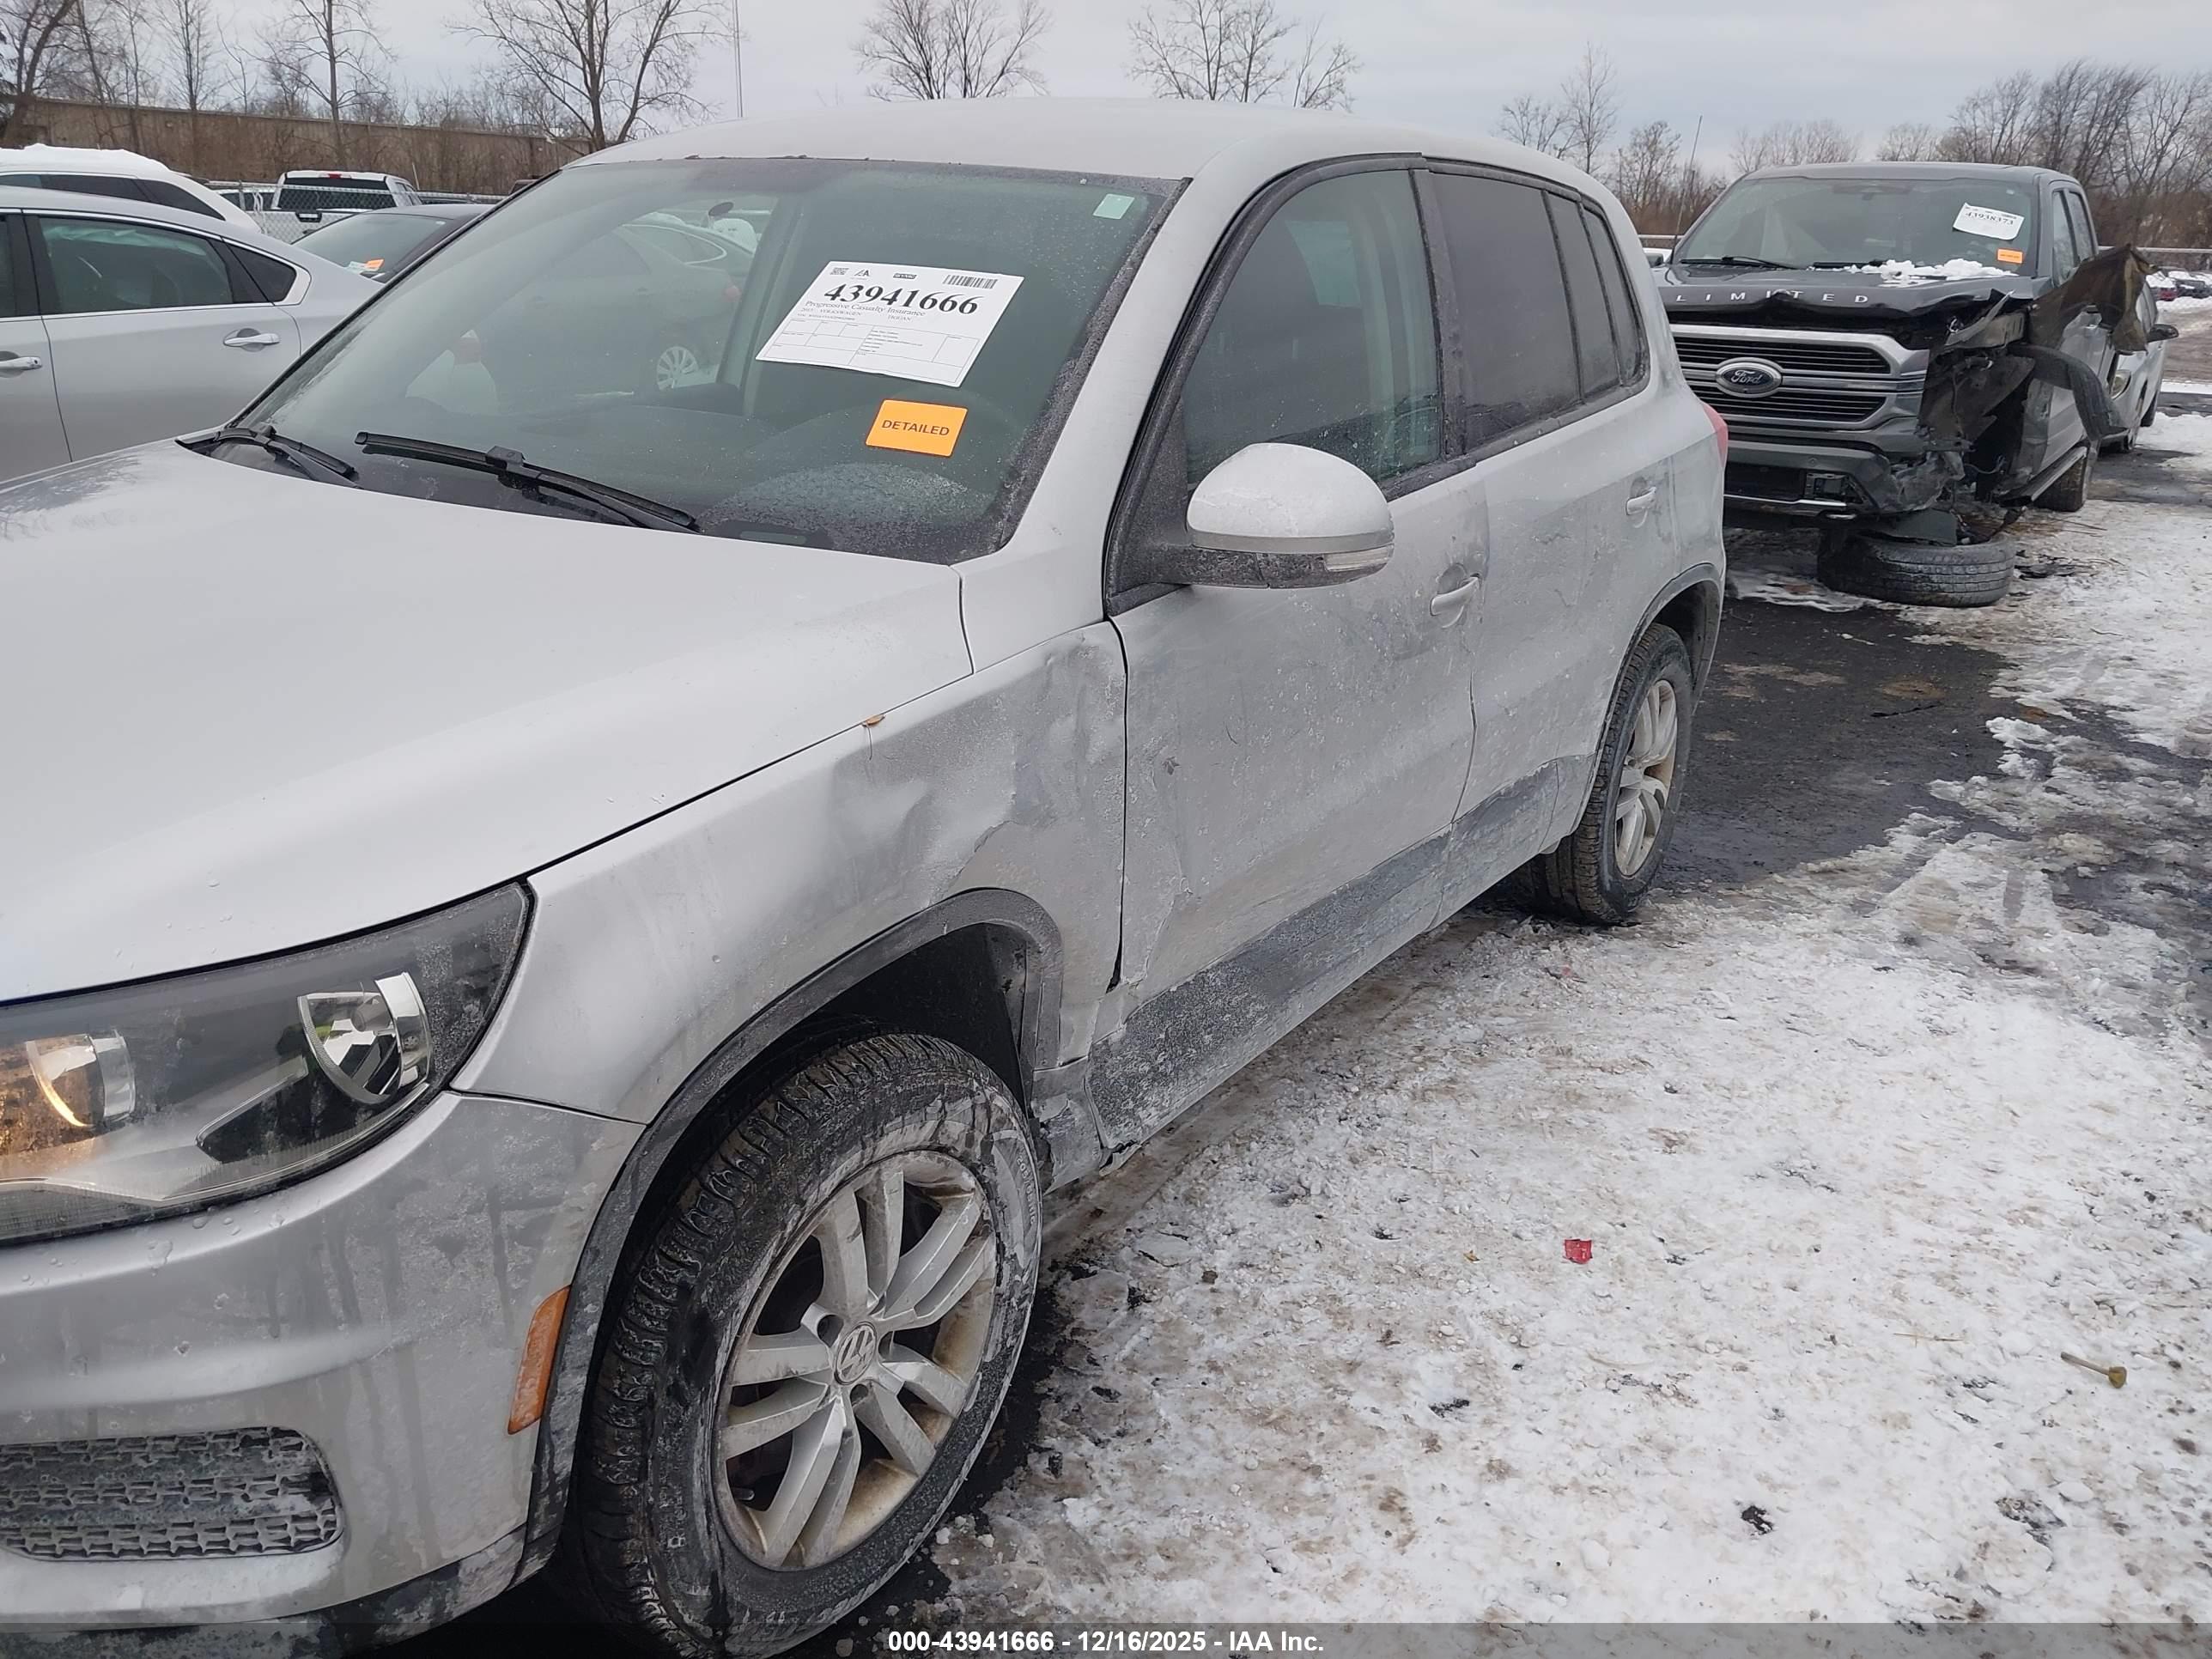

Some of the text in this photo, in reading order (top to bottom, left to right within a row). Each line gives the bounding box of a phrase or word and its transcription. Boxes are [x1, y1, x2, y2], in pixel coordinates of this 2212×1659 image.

[824, 283, 985, 315] 43941666
[1675, 289, 1869, 303] LIMITED
[805, 301, 926, 317] Progressive Casualty Insurance
[1730, 369, 1763, 385] Ford
[881, 419, 951, 437] DETAILED
